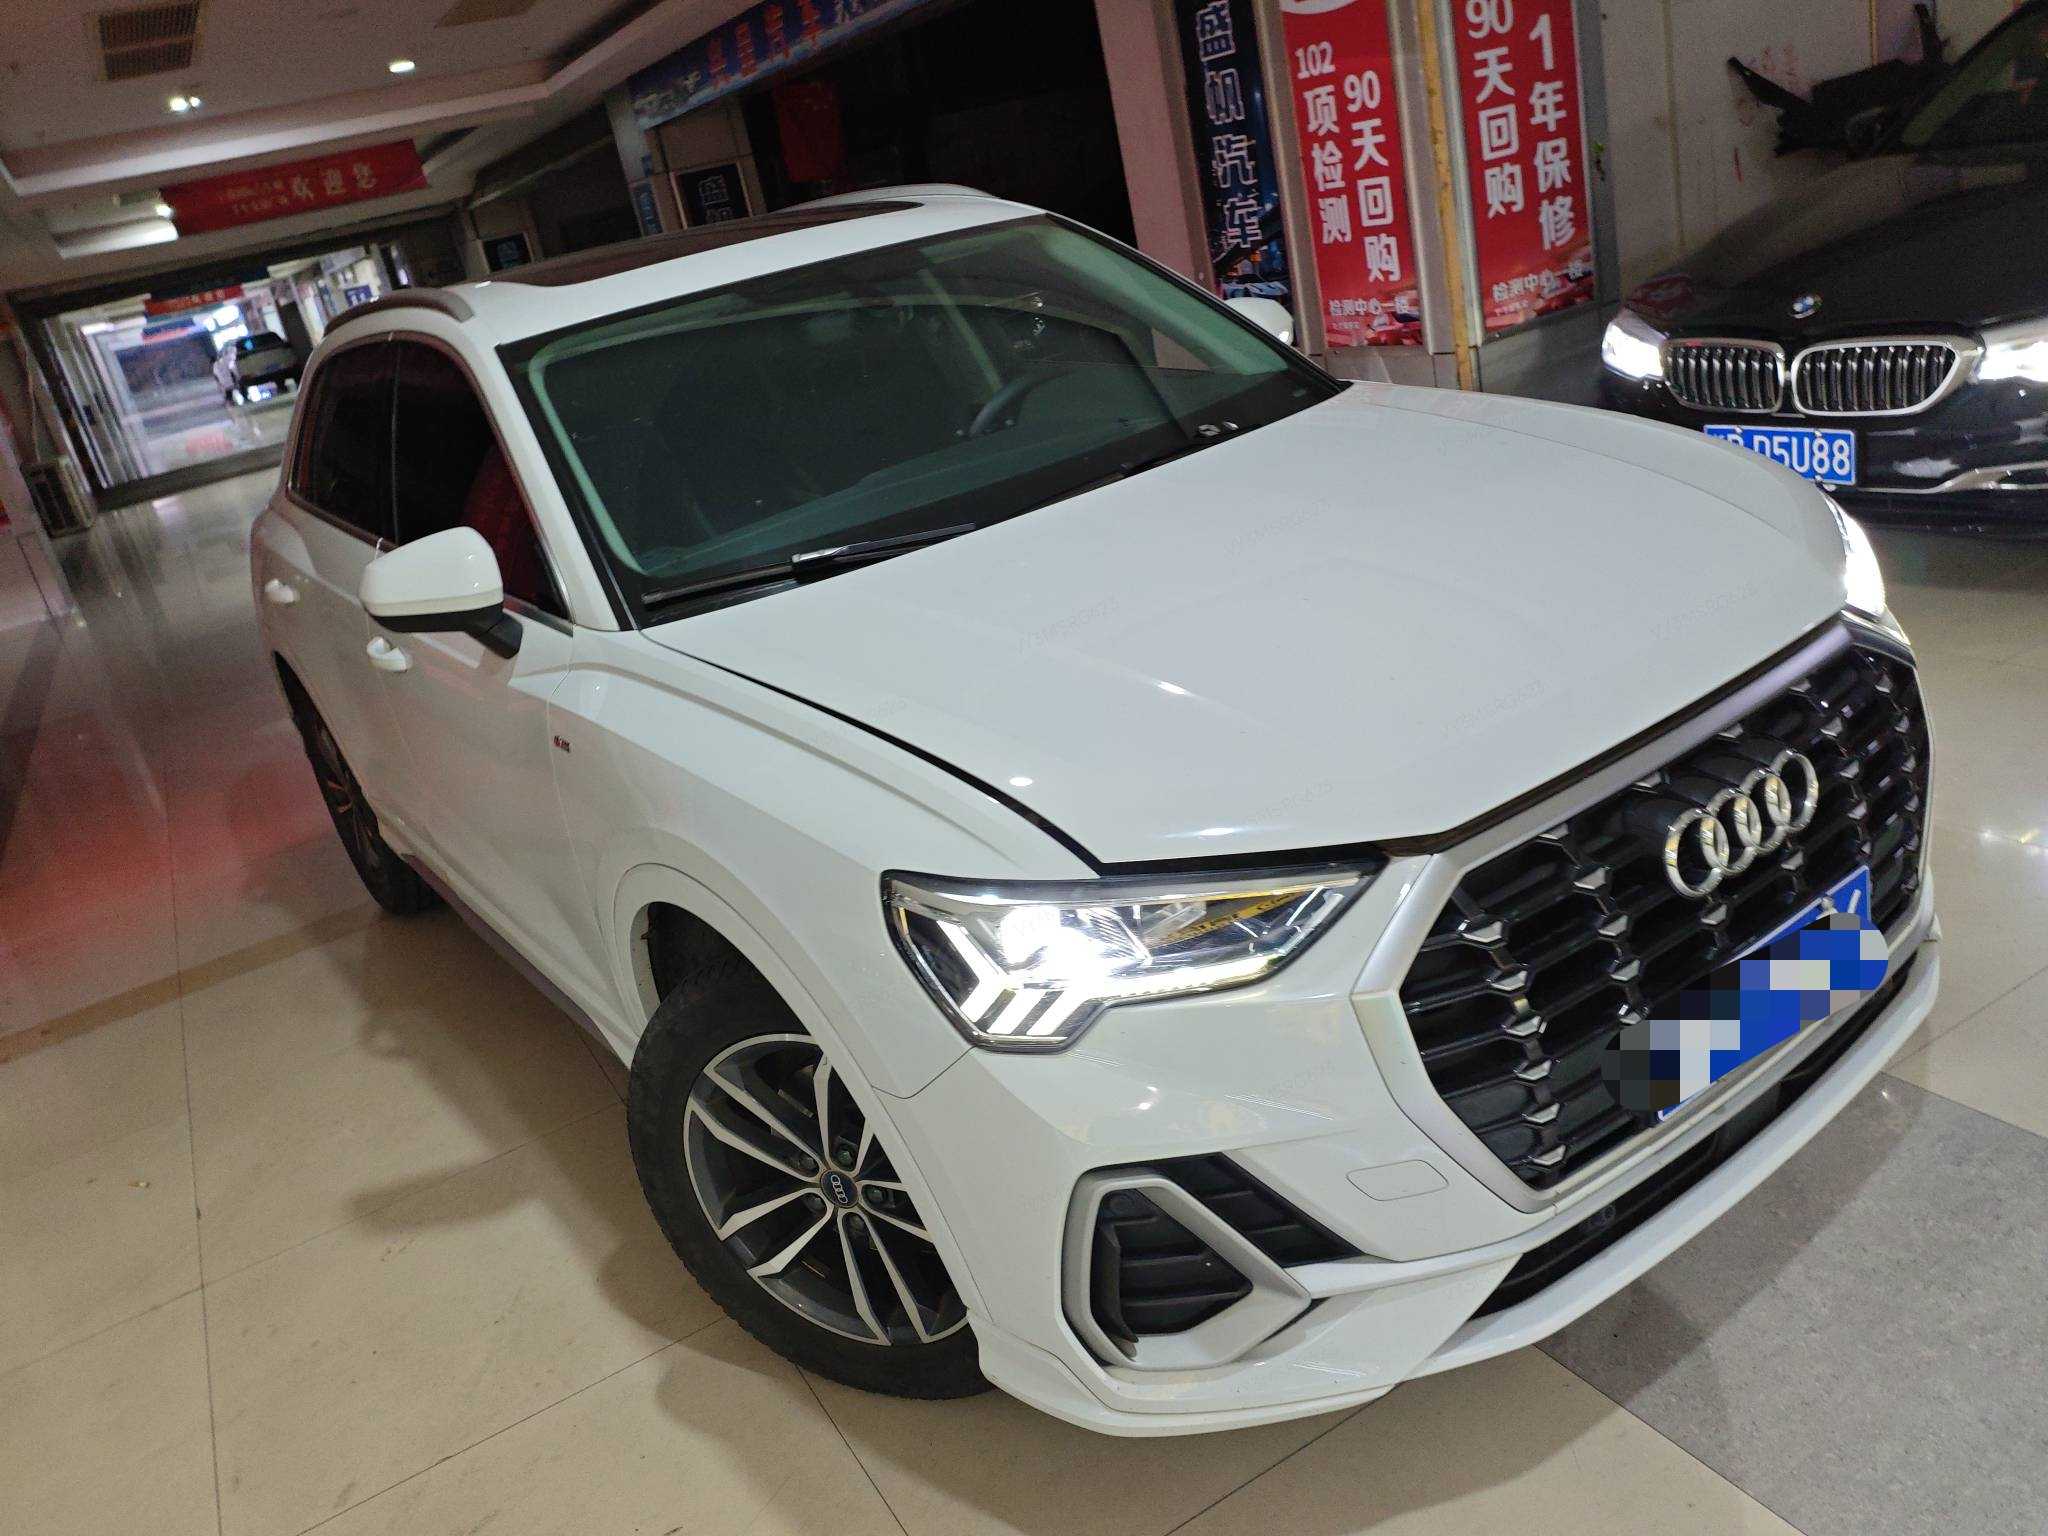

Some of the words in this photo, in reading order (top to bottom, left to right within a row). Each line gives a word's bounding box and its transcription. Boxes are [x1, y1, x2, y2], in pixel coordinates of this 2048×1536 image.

[1343, 70, 1401, 282] 90天回购
[1466, 0, 1525, 220] 90天回购
[1529, 13, 1576, 250] 1年保修
